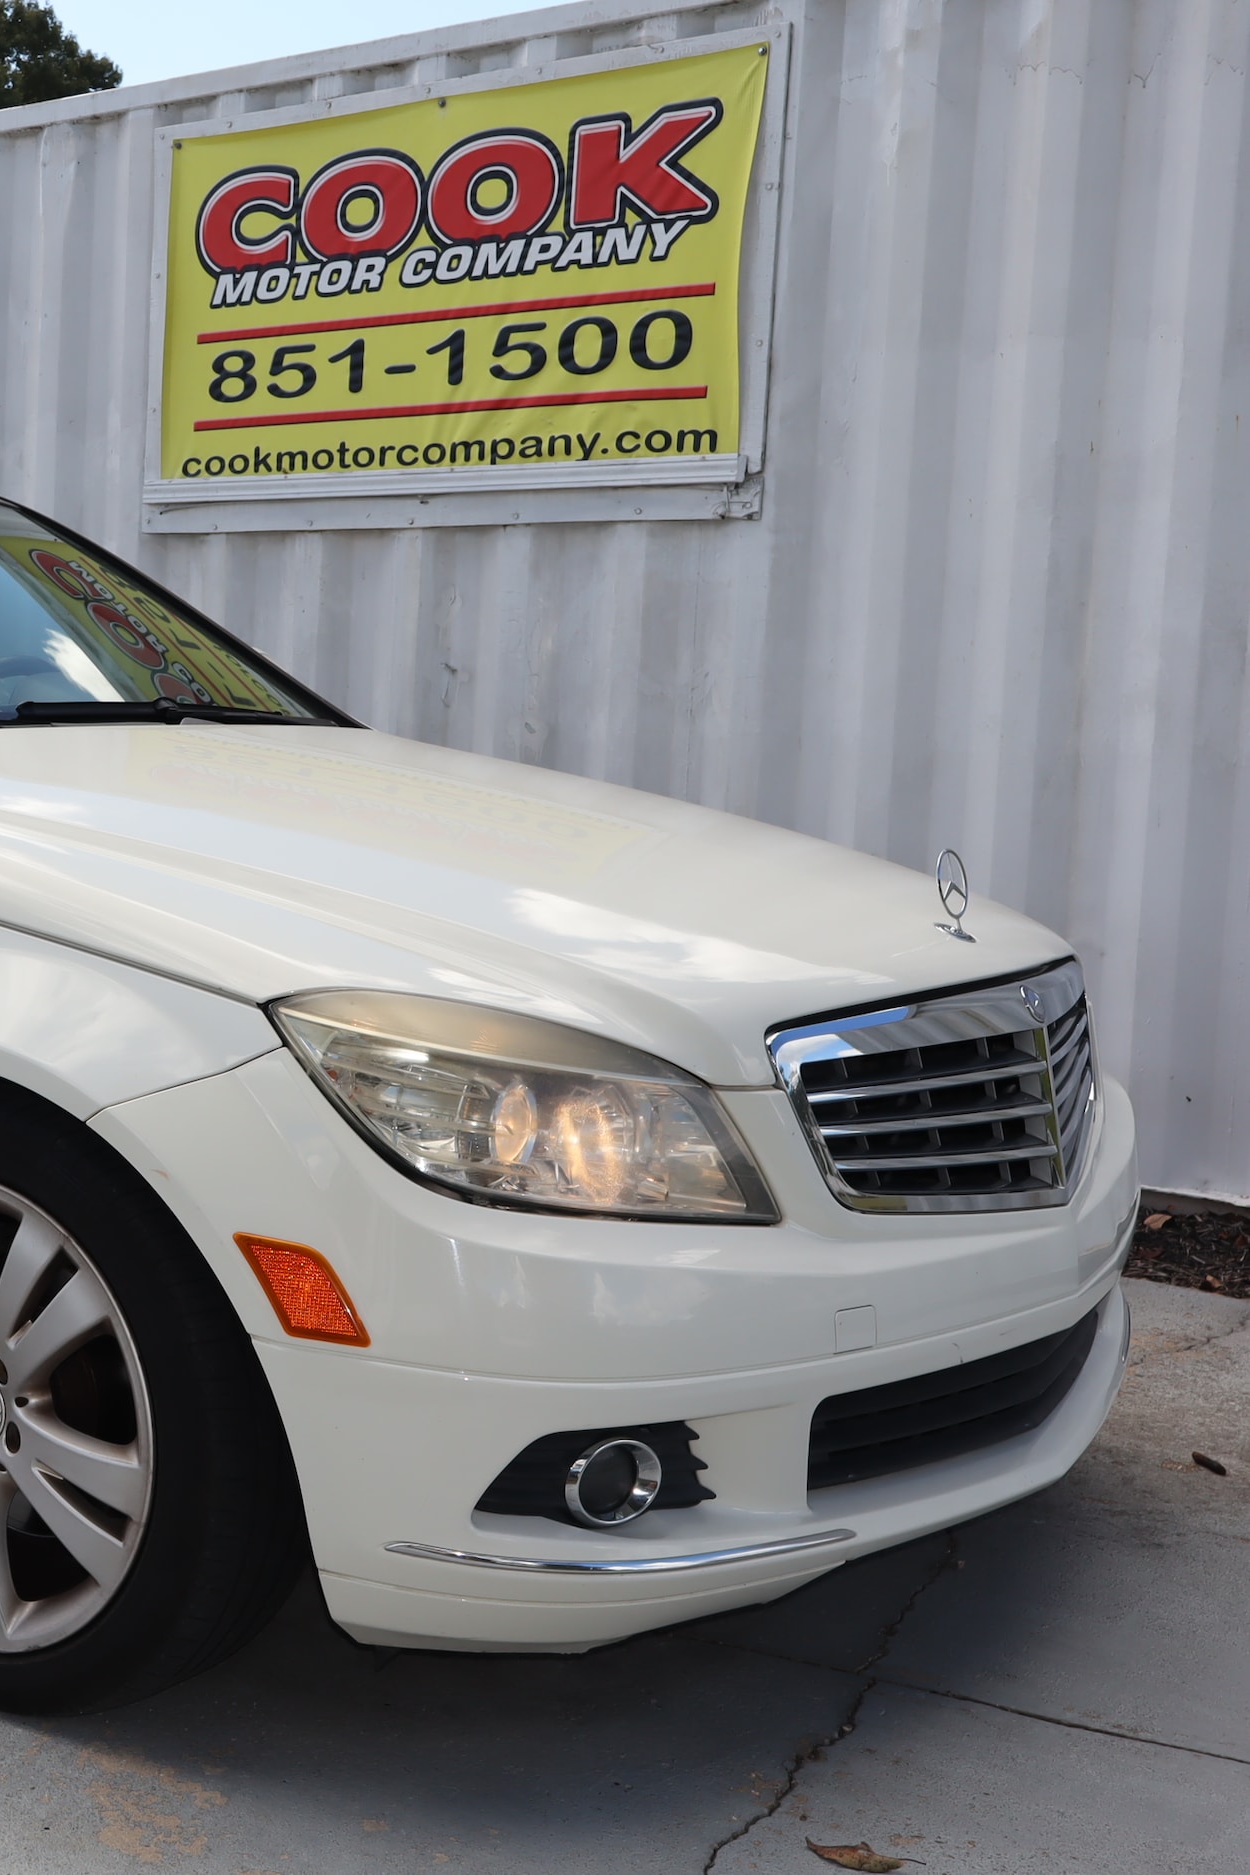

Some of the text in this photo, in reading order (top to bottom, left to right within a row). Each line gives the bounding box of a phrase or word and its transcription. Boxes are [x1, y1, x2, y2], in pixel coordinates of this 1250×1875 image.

[196, 98, 723, 274] COOK
[212, 219, 691, 306] MOTOR COMPANY
[209, 310, 693, 402] 851-1500
[181, 427, 717, 478] cookmotorcompany.com
